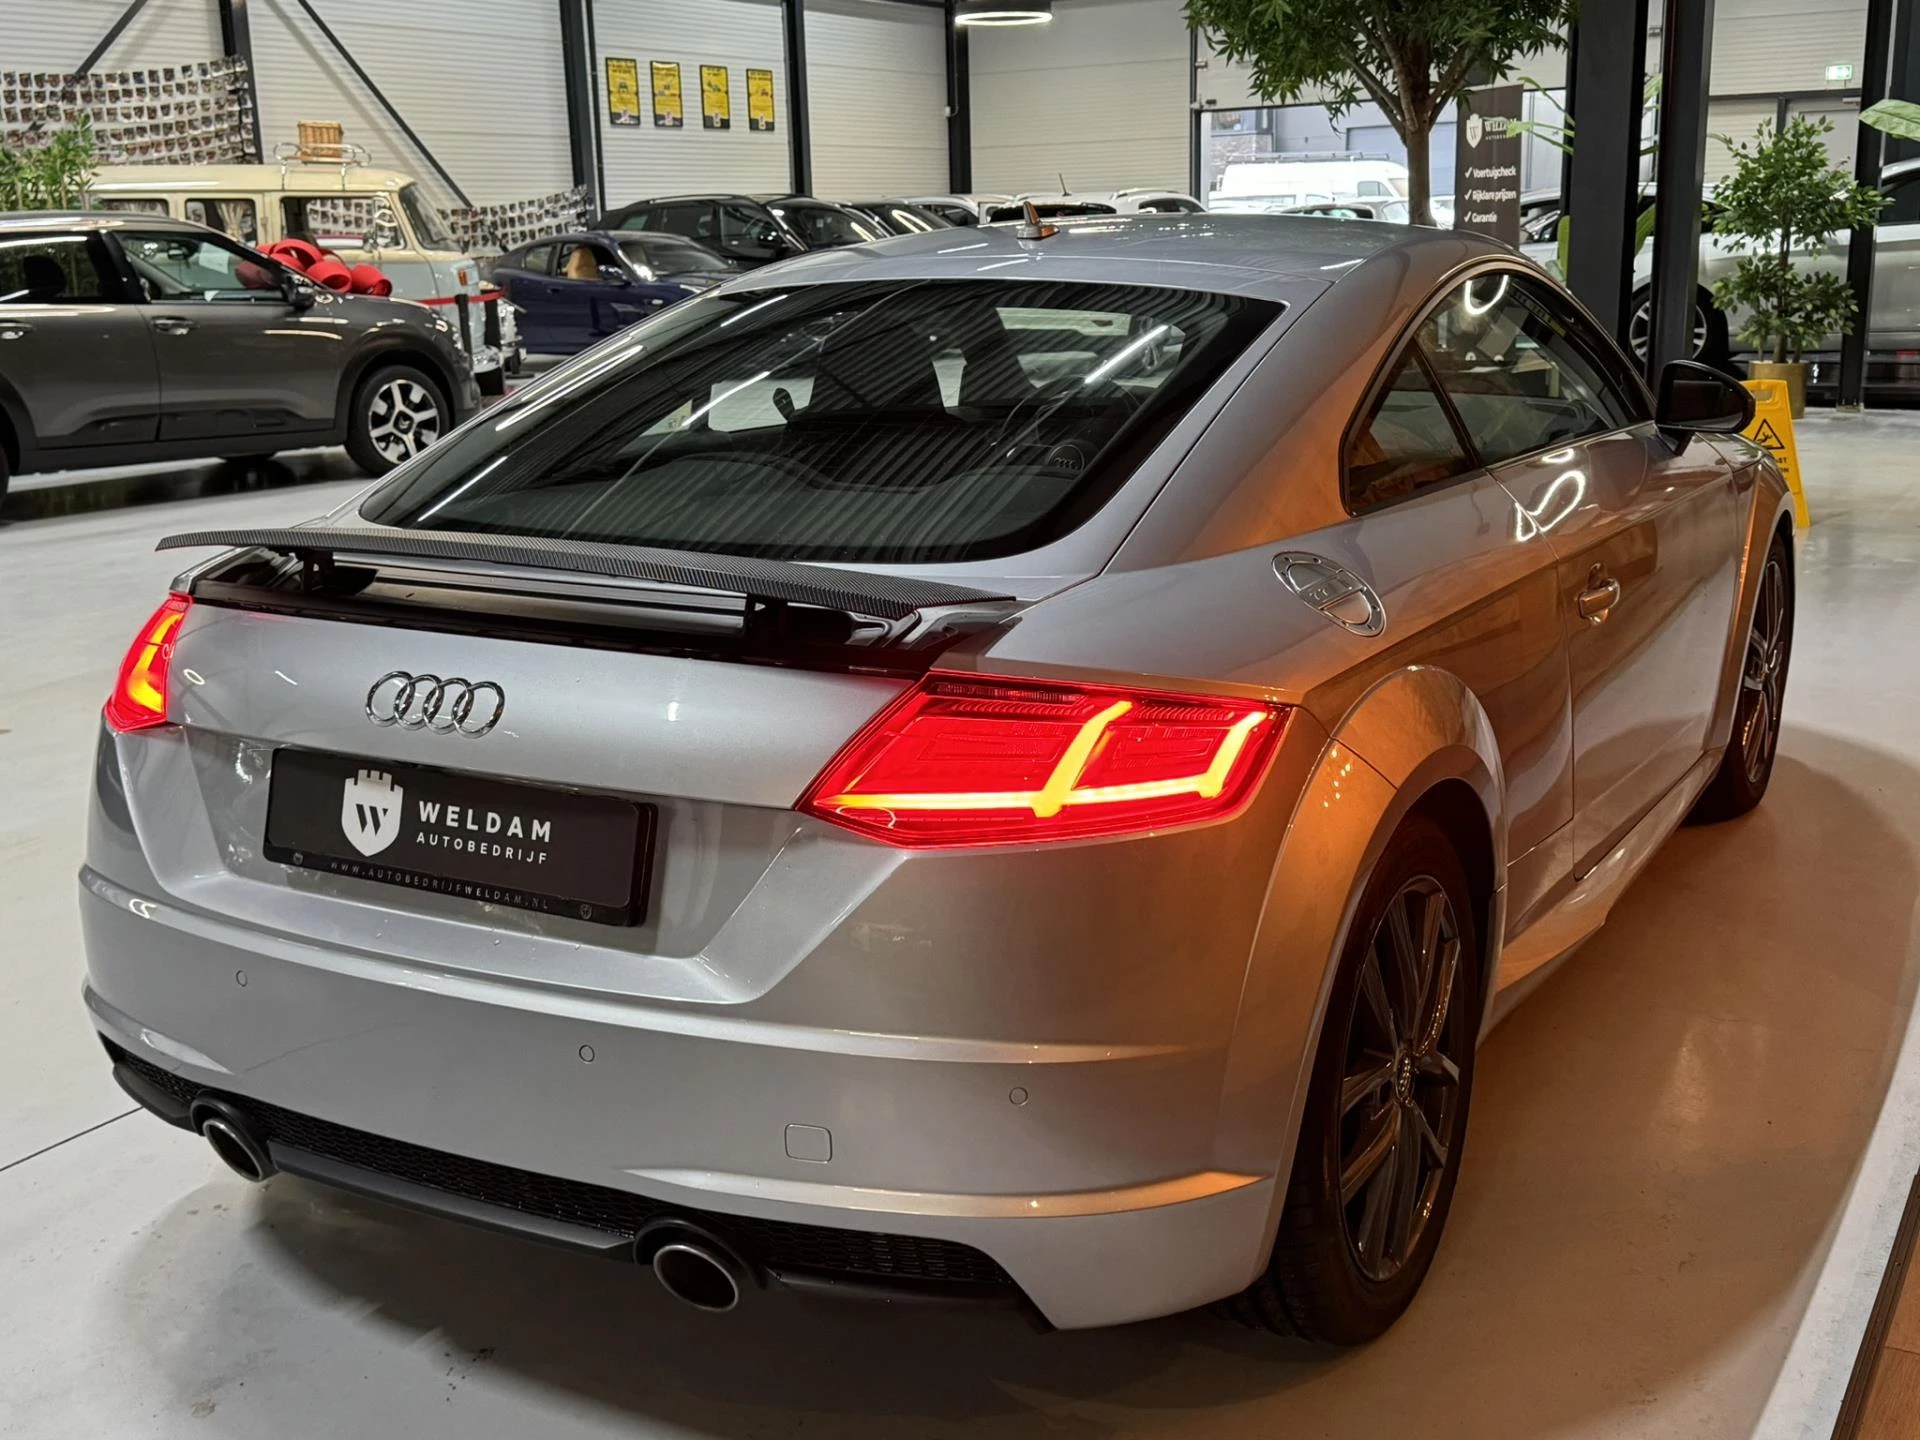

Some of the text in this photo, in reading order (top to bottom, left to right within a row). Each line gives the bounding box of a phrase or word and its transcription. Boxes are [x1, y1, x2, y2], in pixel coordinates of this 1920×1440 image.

[1473, 166, 1516, 179] Voertuigcheck
[1494, 188, 1517, 202] prijzen
[1471, 211, 1498, 223] Garantie
[419, 800, 551, 843] WELDAM
[416, 832, 547, 864] AUTOBEDRIJF
[330, 861, 548, 910] WWW.AUTOBEDRIJFWELDAM.NL
